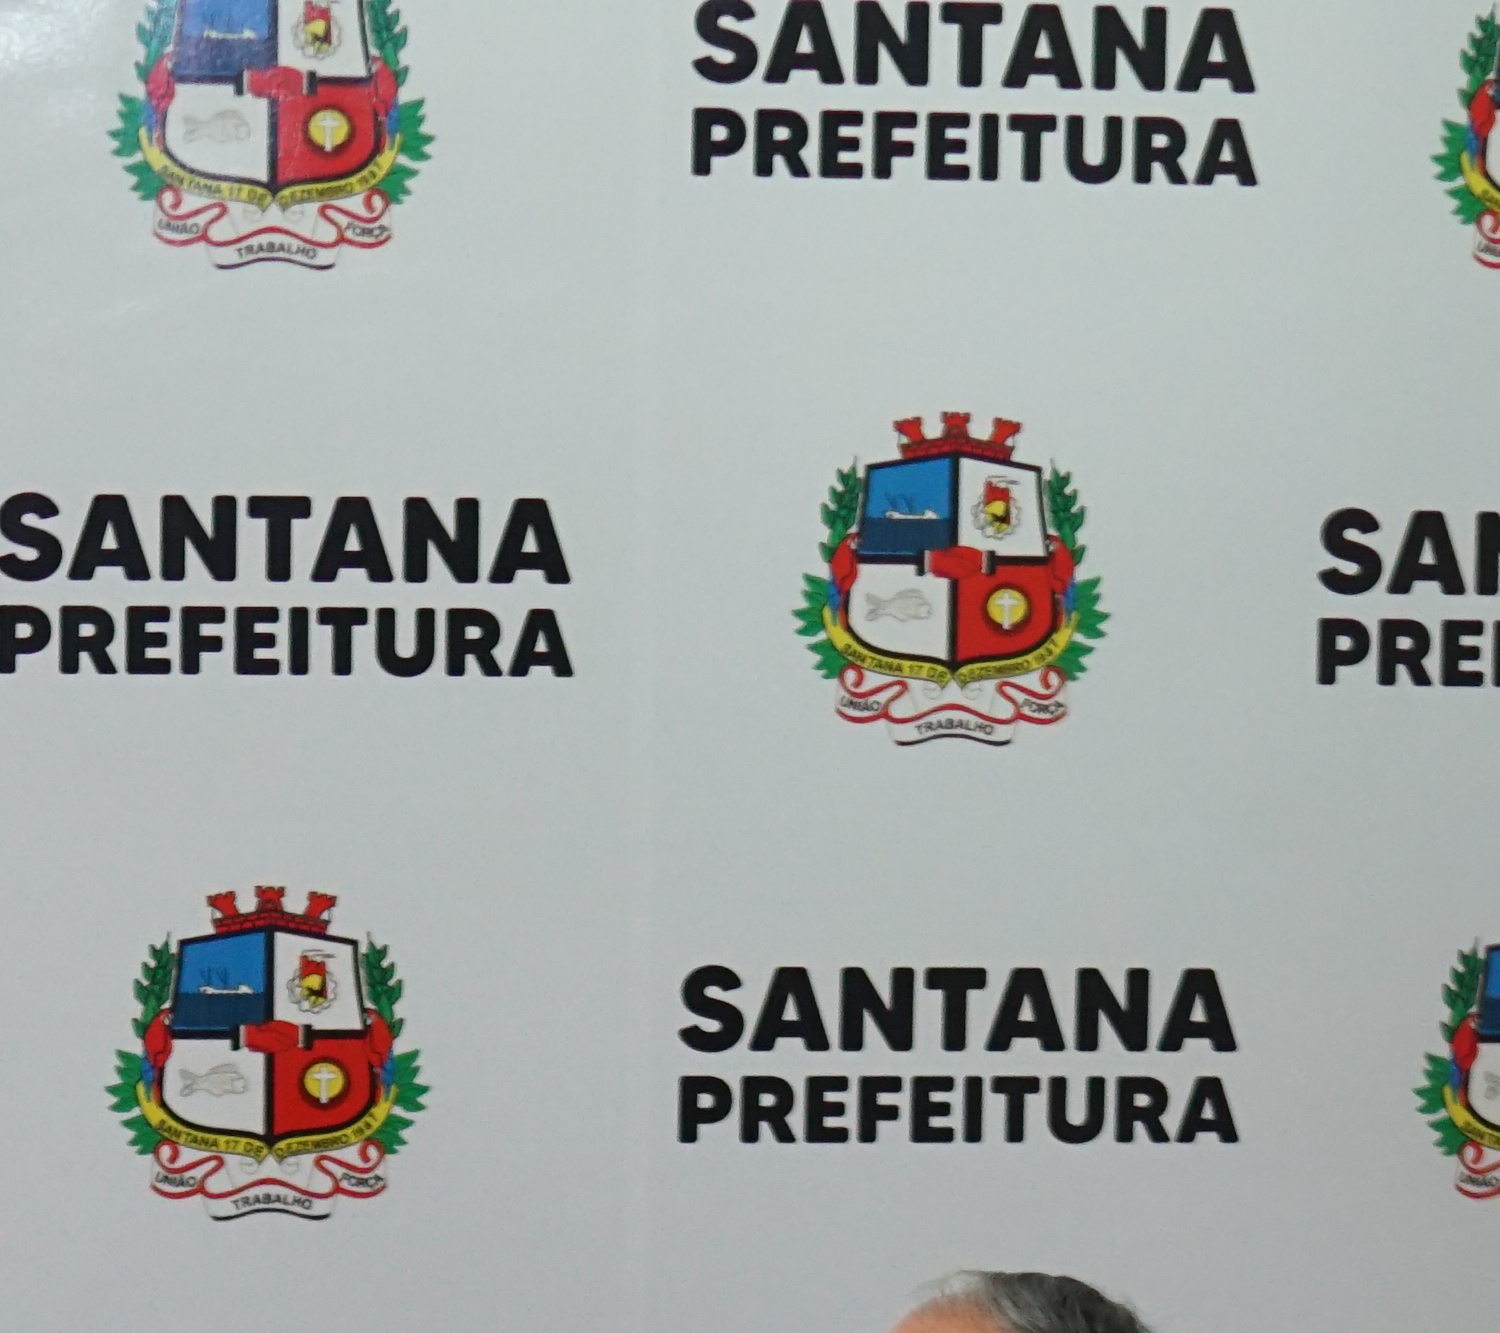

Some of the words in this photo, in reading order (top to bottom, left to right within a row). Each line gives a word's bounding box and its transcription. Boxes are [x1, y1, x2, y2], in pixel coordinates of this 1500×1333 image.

[692, 0, 1256, 93] SANTANA
[692, 107, 1258, 187] PREFEITURA
[915, 717, 995, 737] TRABALHO
[678, 964, 1238, 1054] SANTANA
[678, 1075, 1240, 1145] PREFEITURA
[232, 1192, 313, 1211] TRABALHO
